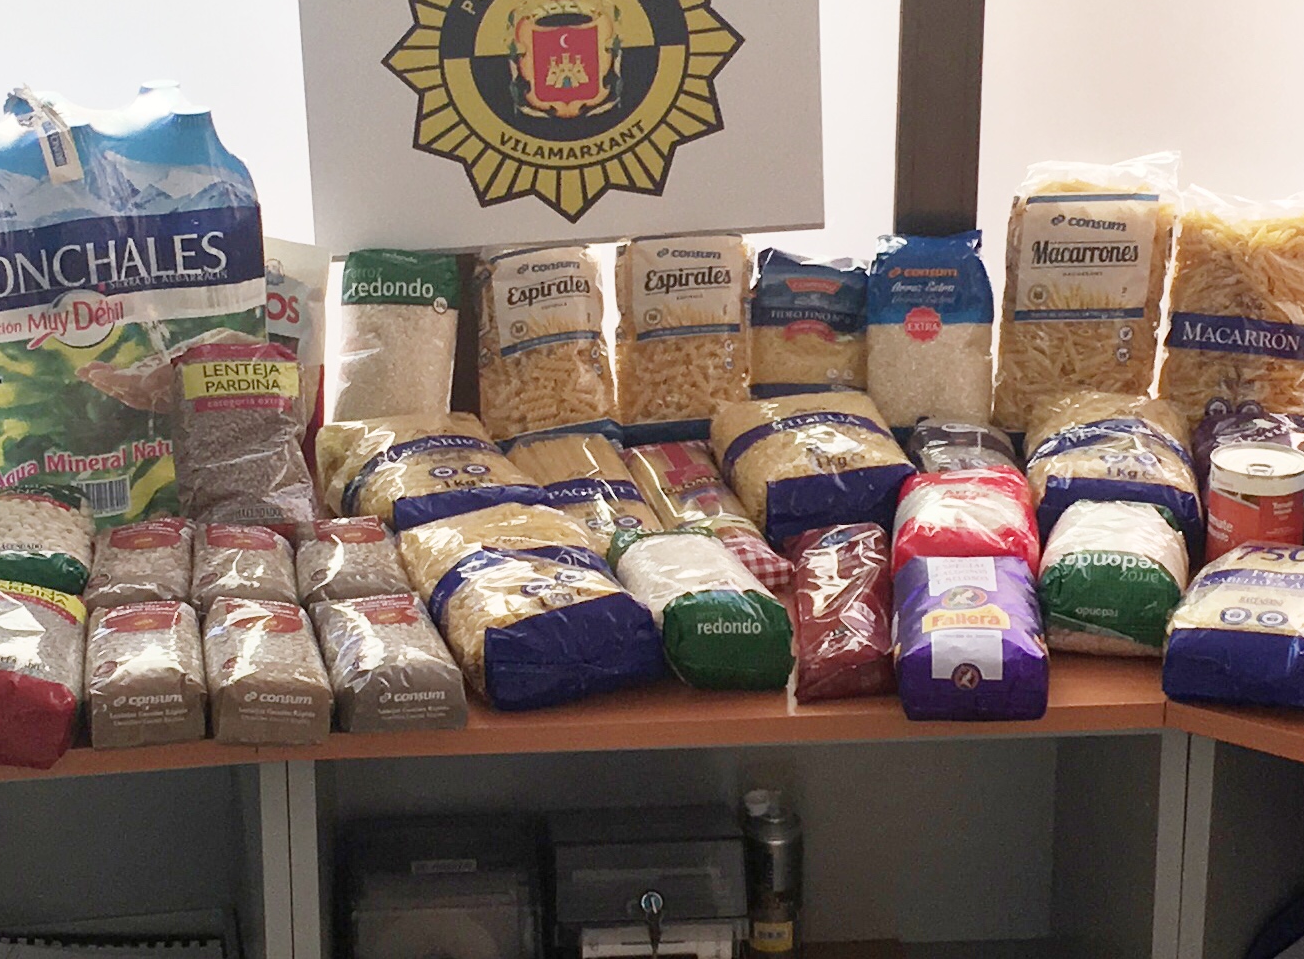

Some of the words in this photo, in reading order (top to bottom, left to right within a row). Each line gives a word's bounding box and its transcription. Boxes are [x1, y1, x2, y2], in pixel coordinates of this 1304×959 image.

[499, 119, 645, 162] VILAMARXANT
[1068, 217, 1127, 232] consum
[671, 250, 721, 259] consum
[1031, 240, 1139, 264] Macarrones
[532, 261, 580, 272] consum
[903, 268, 958, 277] consum
[351, 277, 434, 298] redondo
[644, 266, 731, 294] Espirales
[507, 275, 590, 307] Espirales
[28, 310, 69, 336] Muy
[73, 299, 124, 331] Débil
[907, 322, 940, 331] EXTRA
[1182, 321, 1300, 351] MACARRÓN
[203, 363, 281, 379] LENTEJA
[205, 378, 282, 393] PARDINA
[45, 447, 127, 473] Mineral
[931, 612, 1001, 628] Fallera
[1075, 607, 1119, 618] redondo
[697, 618, 762, 635] redondo
[128, 694, 183, 706] consum
[259, 693, 313, 705] consum
[394, 691, 445, 702] consum
